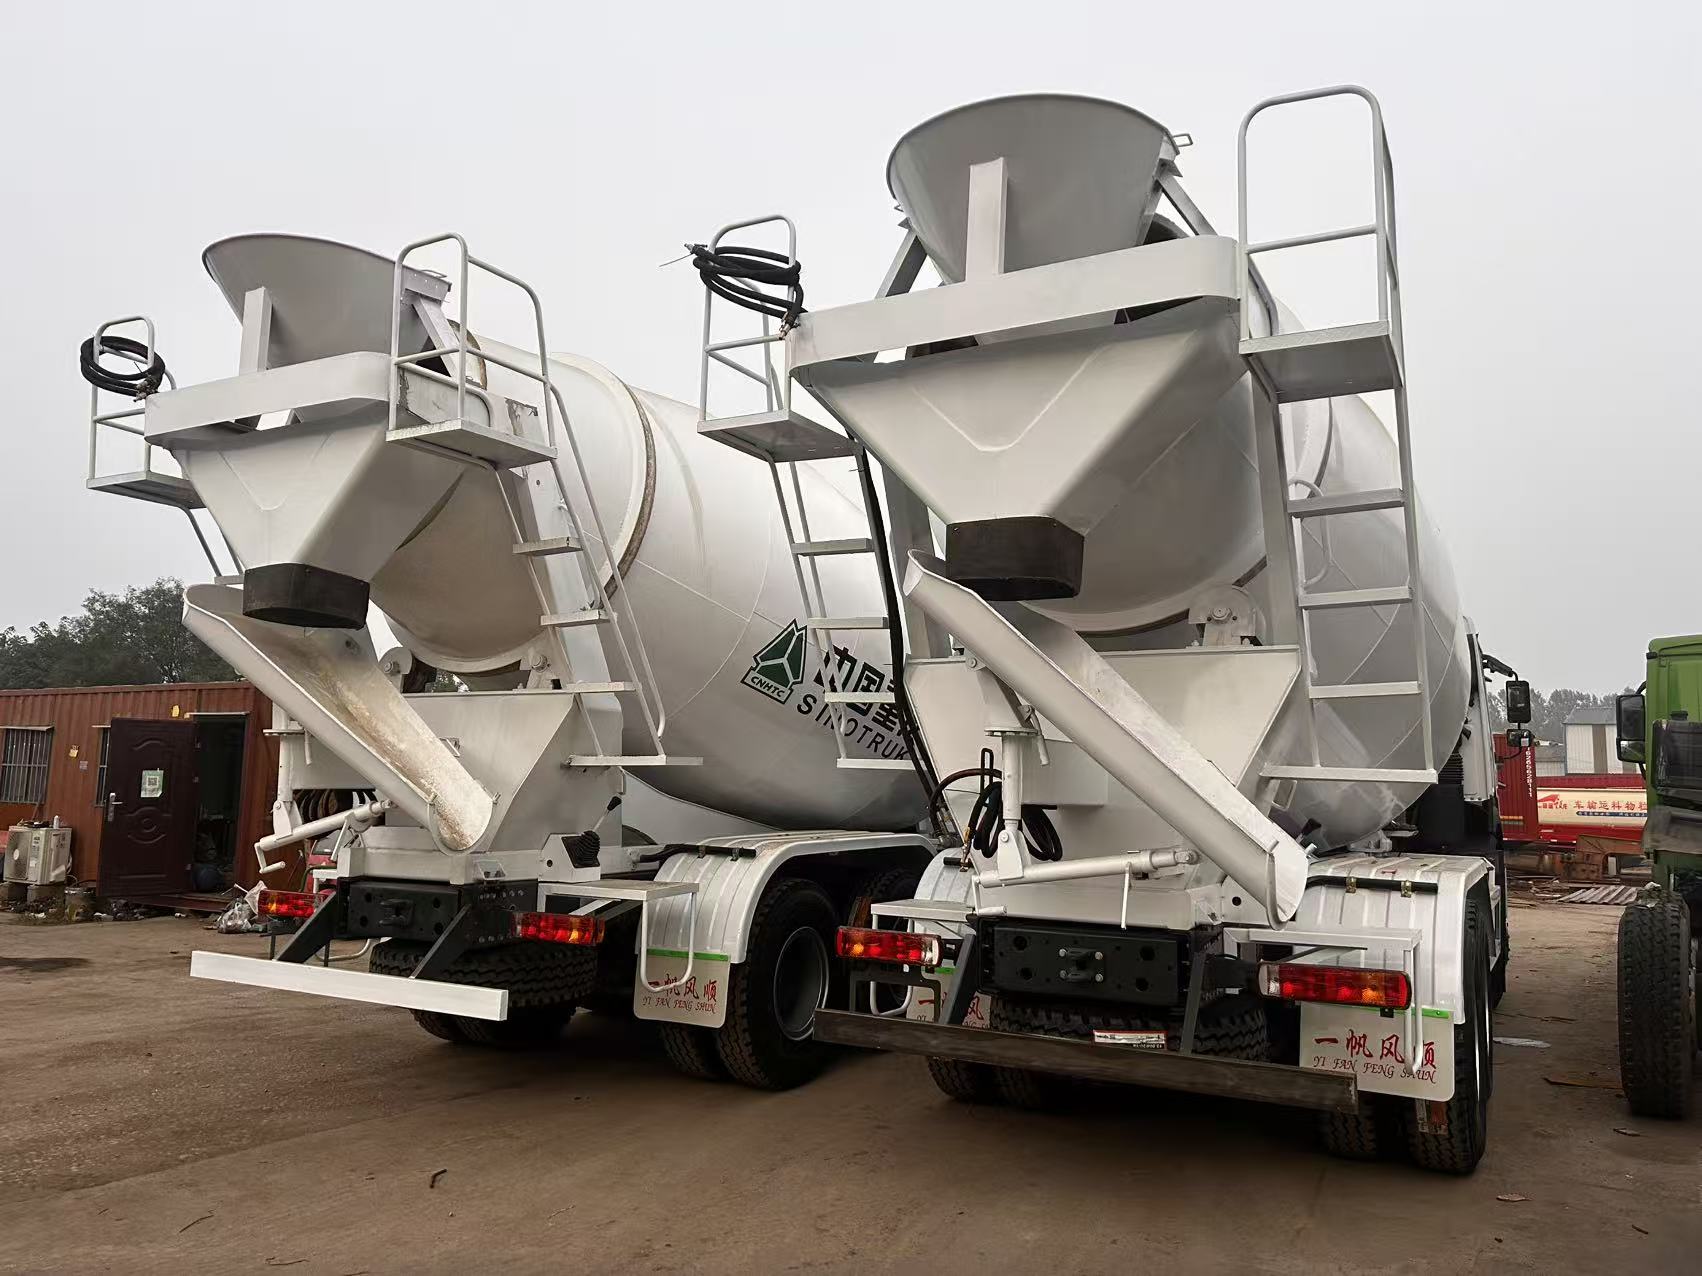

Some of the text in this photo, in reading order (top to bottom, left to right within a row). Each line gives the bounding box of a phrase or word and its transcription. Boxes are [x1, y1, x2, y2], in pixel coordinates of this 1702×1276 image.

[751, 676, 785, 697] CNHTC
[1332, 1058, 1358, 1073] FAN
[1362, 1062, 1395, 1079] FENG
